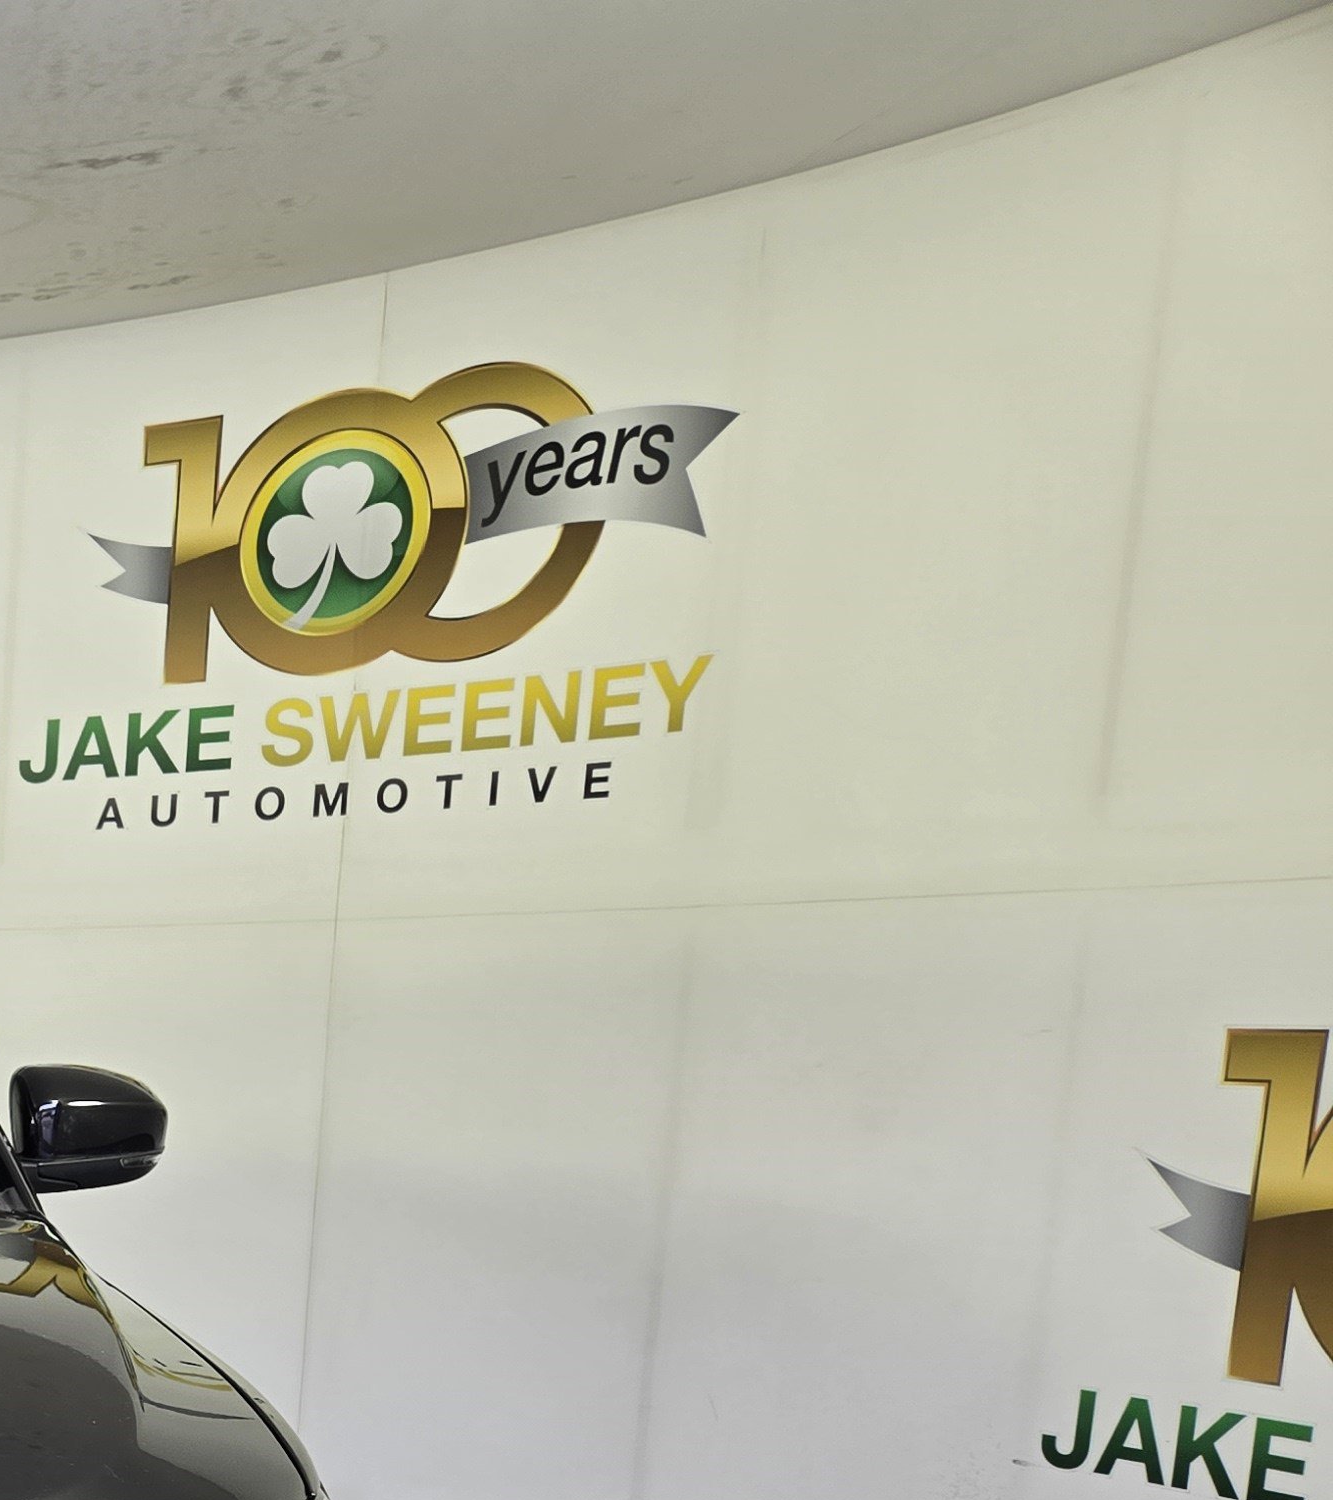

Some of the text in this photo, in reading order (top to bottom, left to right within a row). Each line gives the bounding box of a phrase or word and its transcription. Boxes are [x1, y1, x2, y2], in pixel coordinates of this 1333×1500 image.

[144, 362, 605, 684] 100
[480, 423, 675, 527] years
[19, 654, 714, 784] JAKE SWEENEY
[95, 762, 613, 830] AUTOMOTIVE
